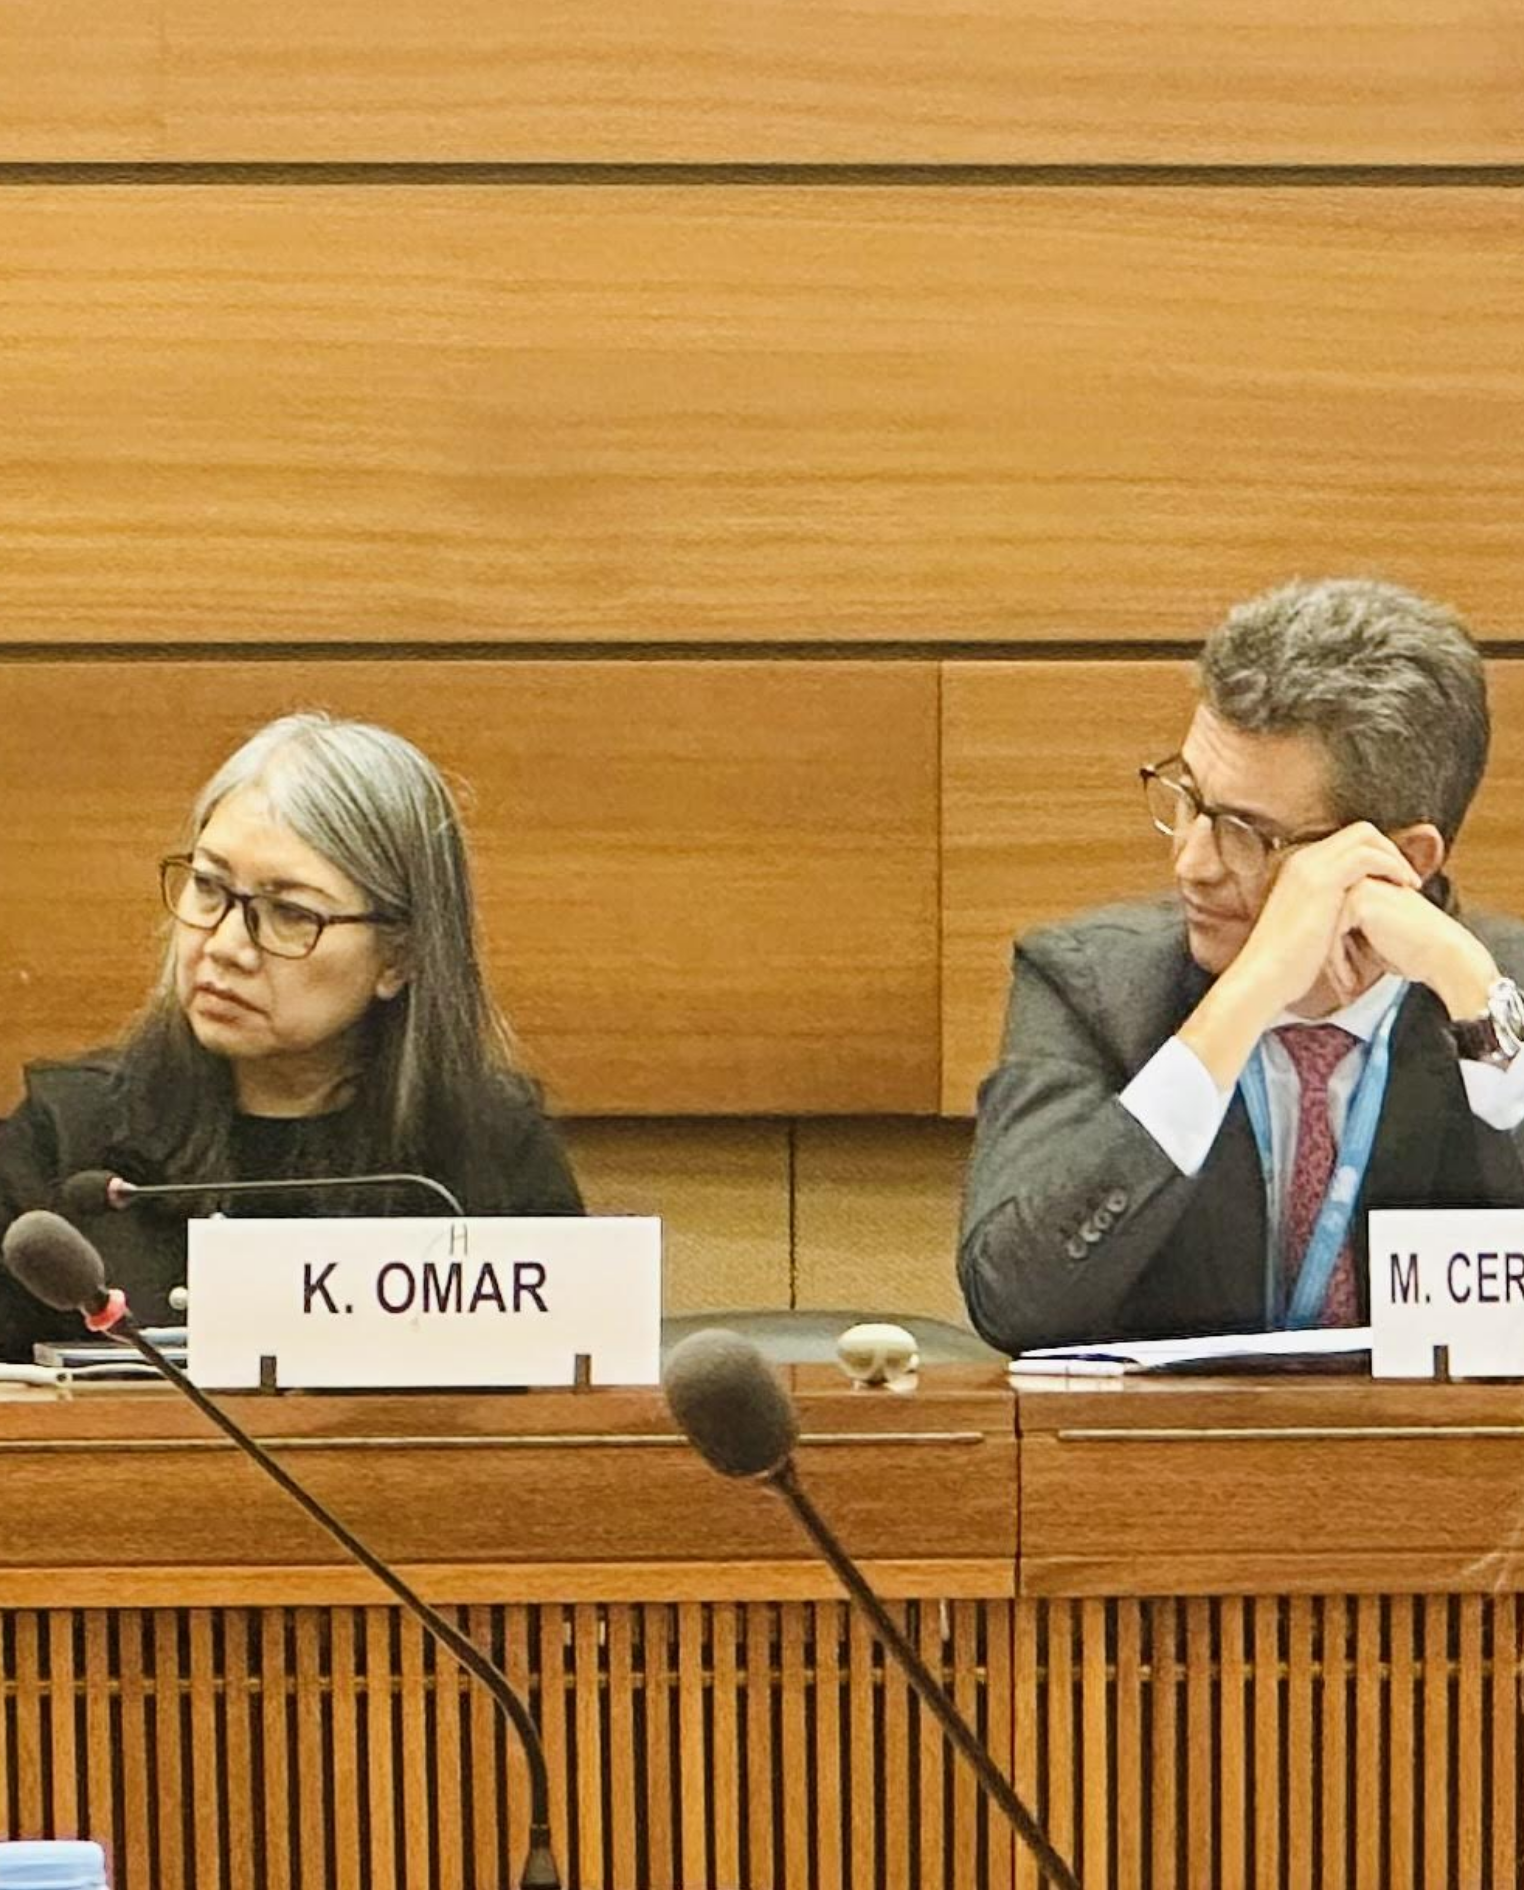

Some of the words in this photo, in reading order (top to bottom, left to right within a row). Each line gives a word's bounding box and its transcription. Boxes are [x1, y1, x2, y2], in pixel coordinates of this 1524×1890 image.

[302, 1262, 354, 1314] K.
[376, 1261, 549, 1314] OMAR
[1390, 1252, 1431, 1304] M.
